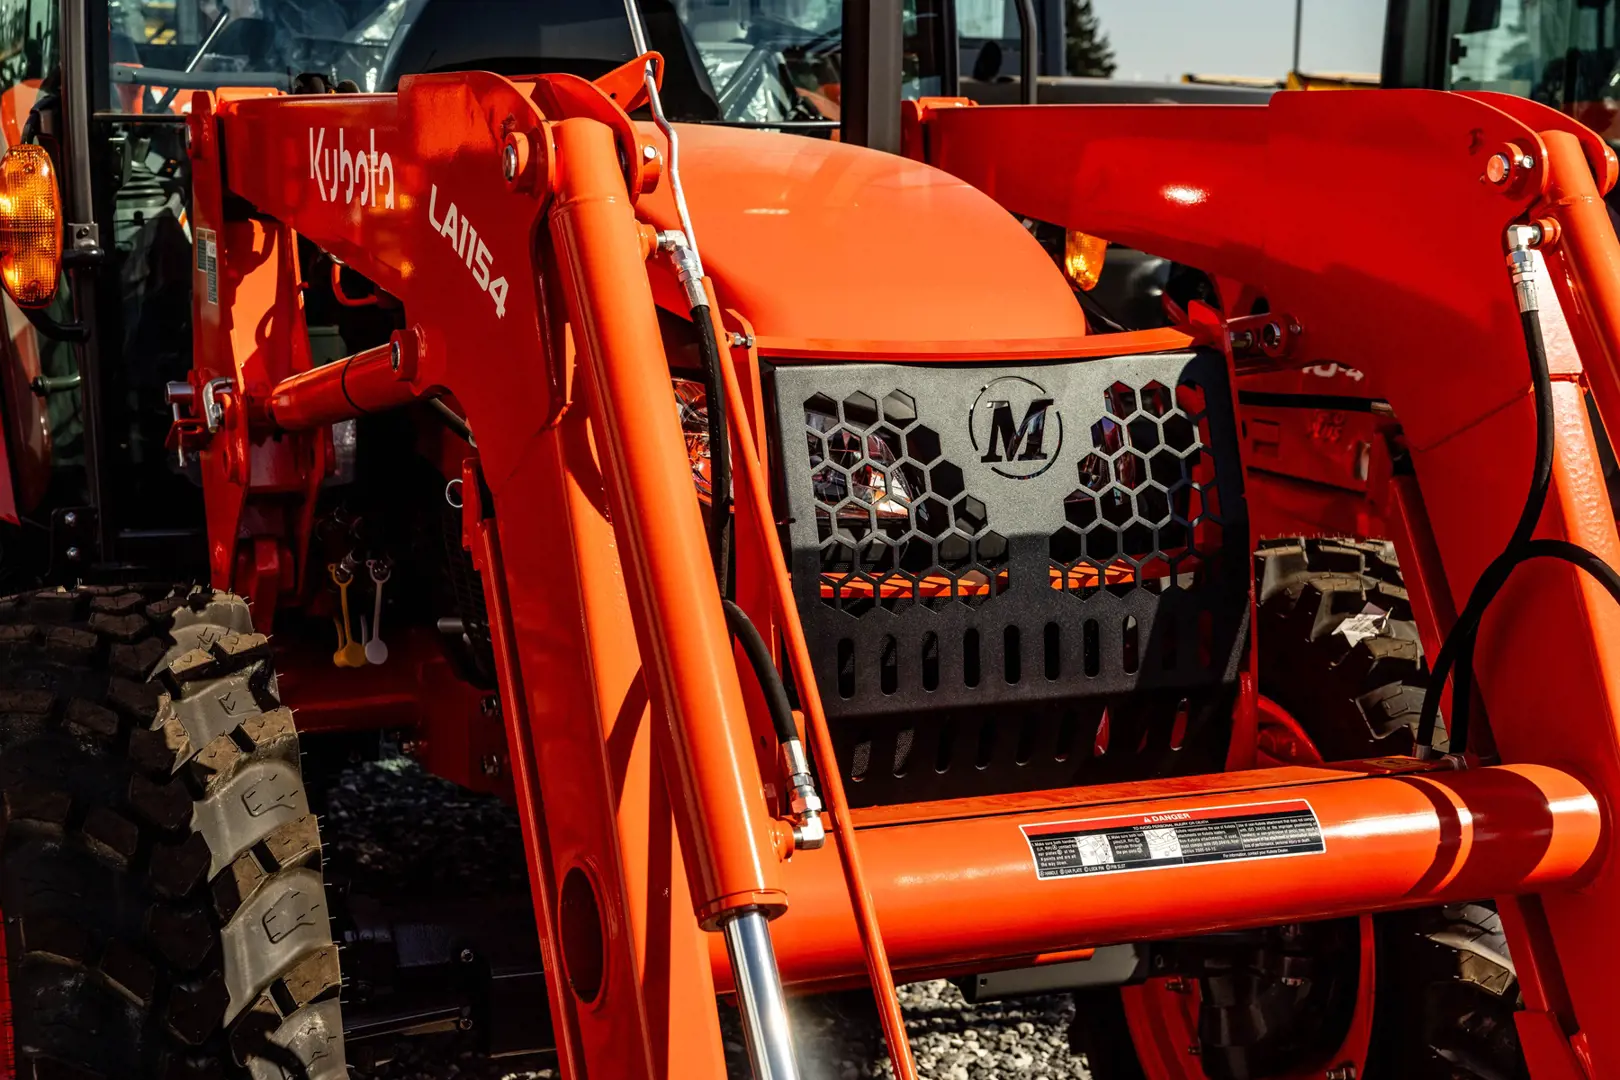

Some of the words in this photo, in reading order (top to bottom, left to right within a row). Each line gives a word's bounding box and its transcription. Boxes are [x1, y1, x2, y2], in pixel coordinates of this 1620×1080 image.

[309, 127, 395, 210] Kubota
[429, 184, 509, 319] LA1154
[980, 398, 1054, 463] M
[1152, 813, 1191, 822] DANGER
